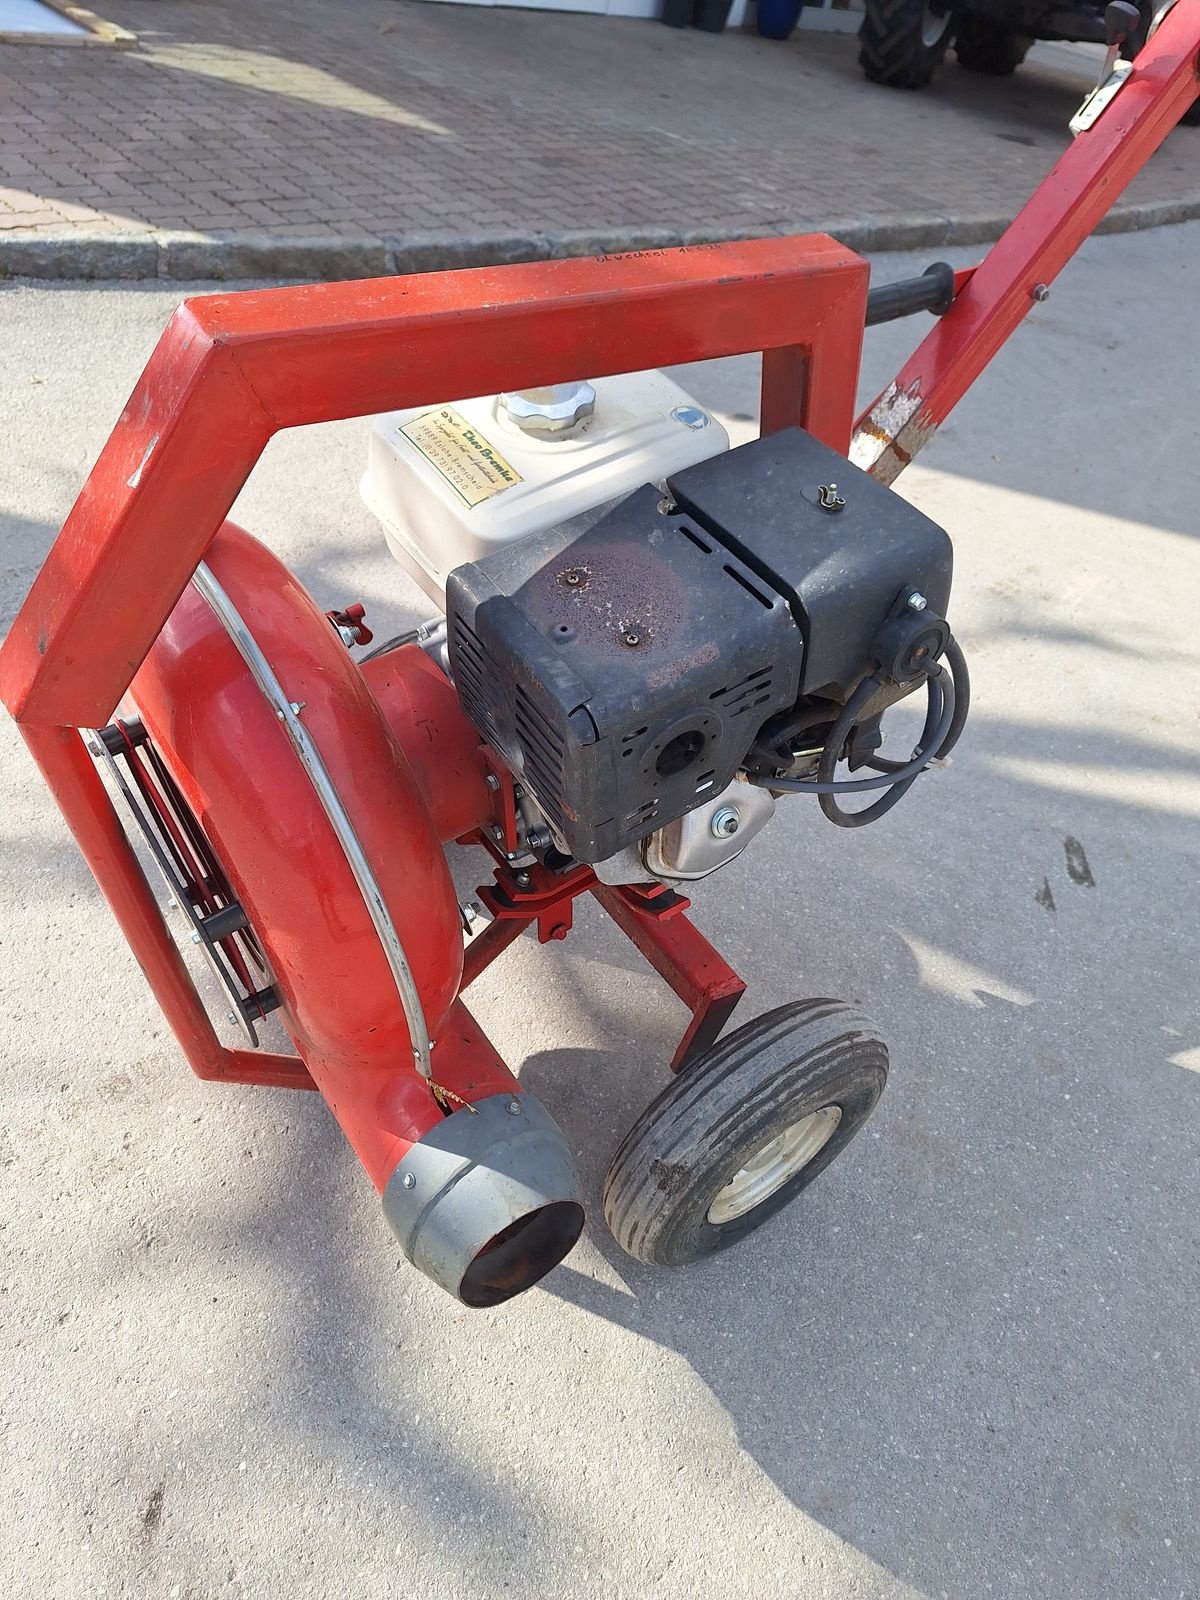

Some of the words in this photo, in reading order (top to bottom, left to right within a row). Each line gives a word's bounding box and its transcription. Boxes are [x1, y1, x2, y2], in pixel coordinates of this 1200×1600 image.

[419, 424, 437, 441] 59889
[461, 429, 483, 450] Theo
[479, 447, 515, 482] Bremke
